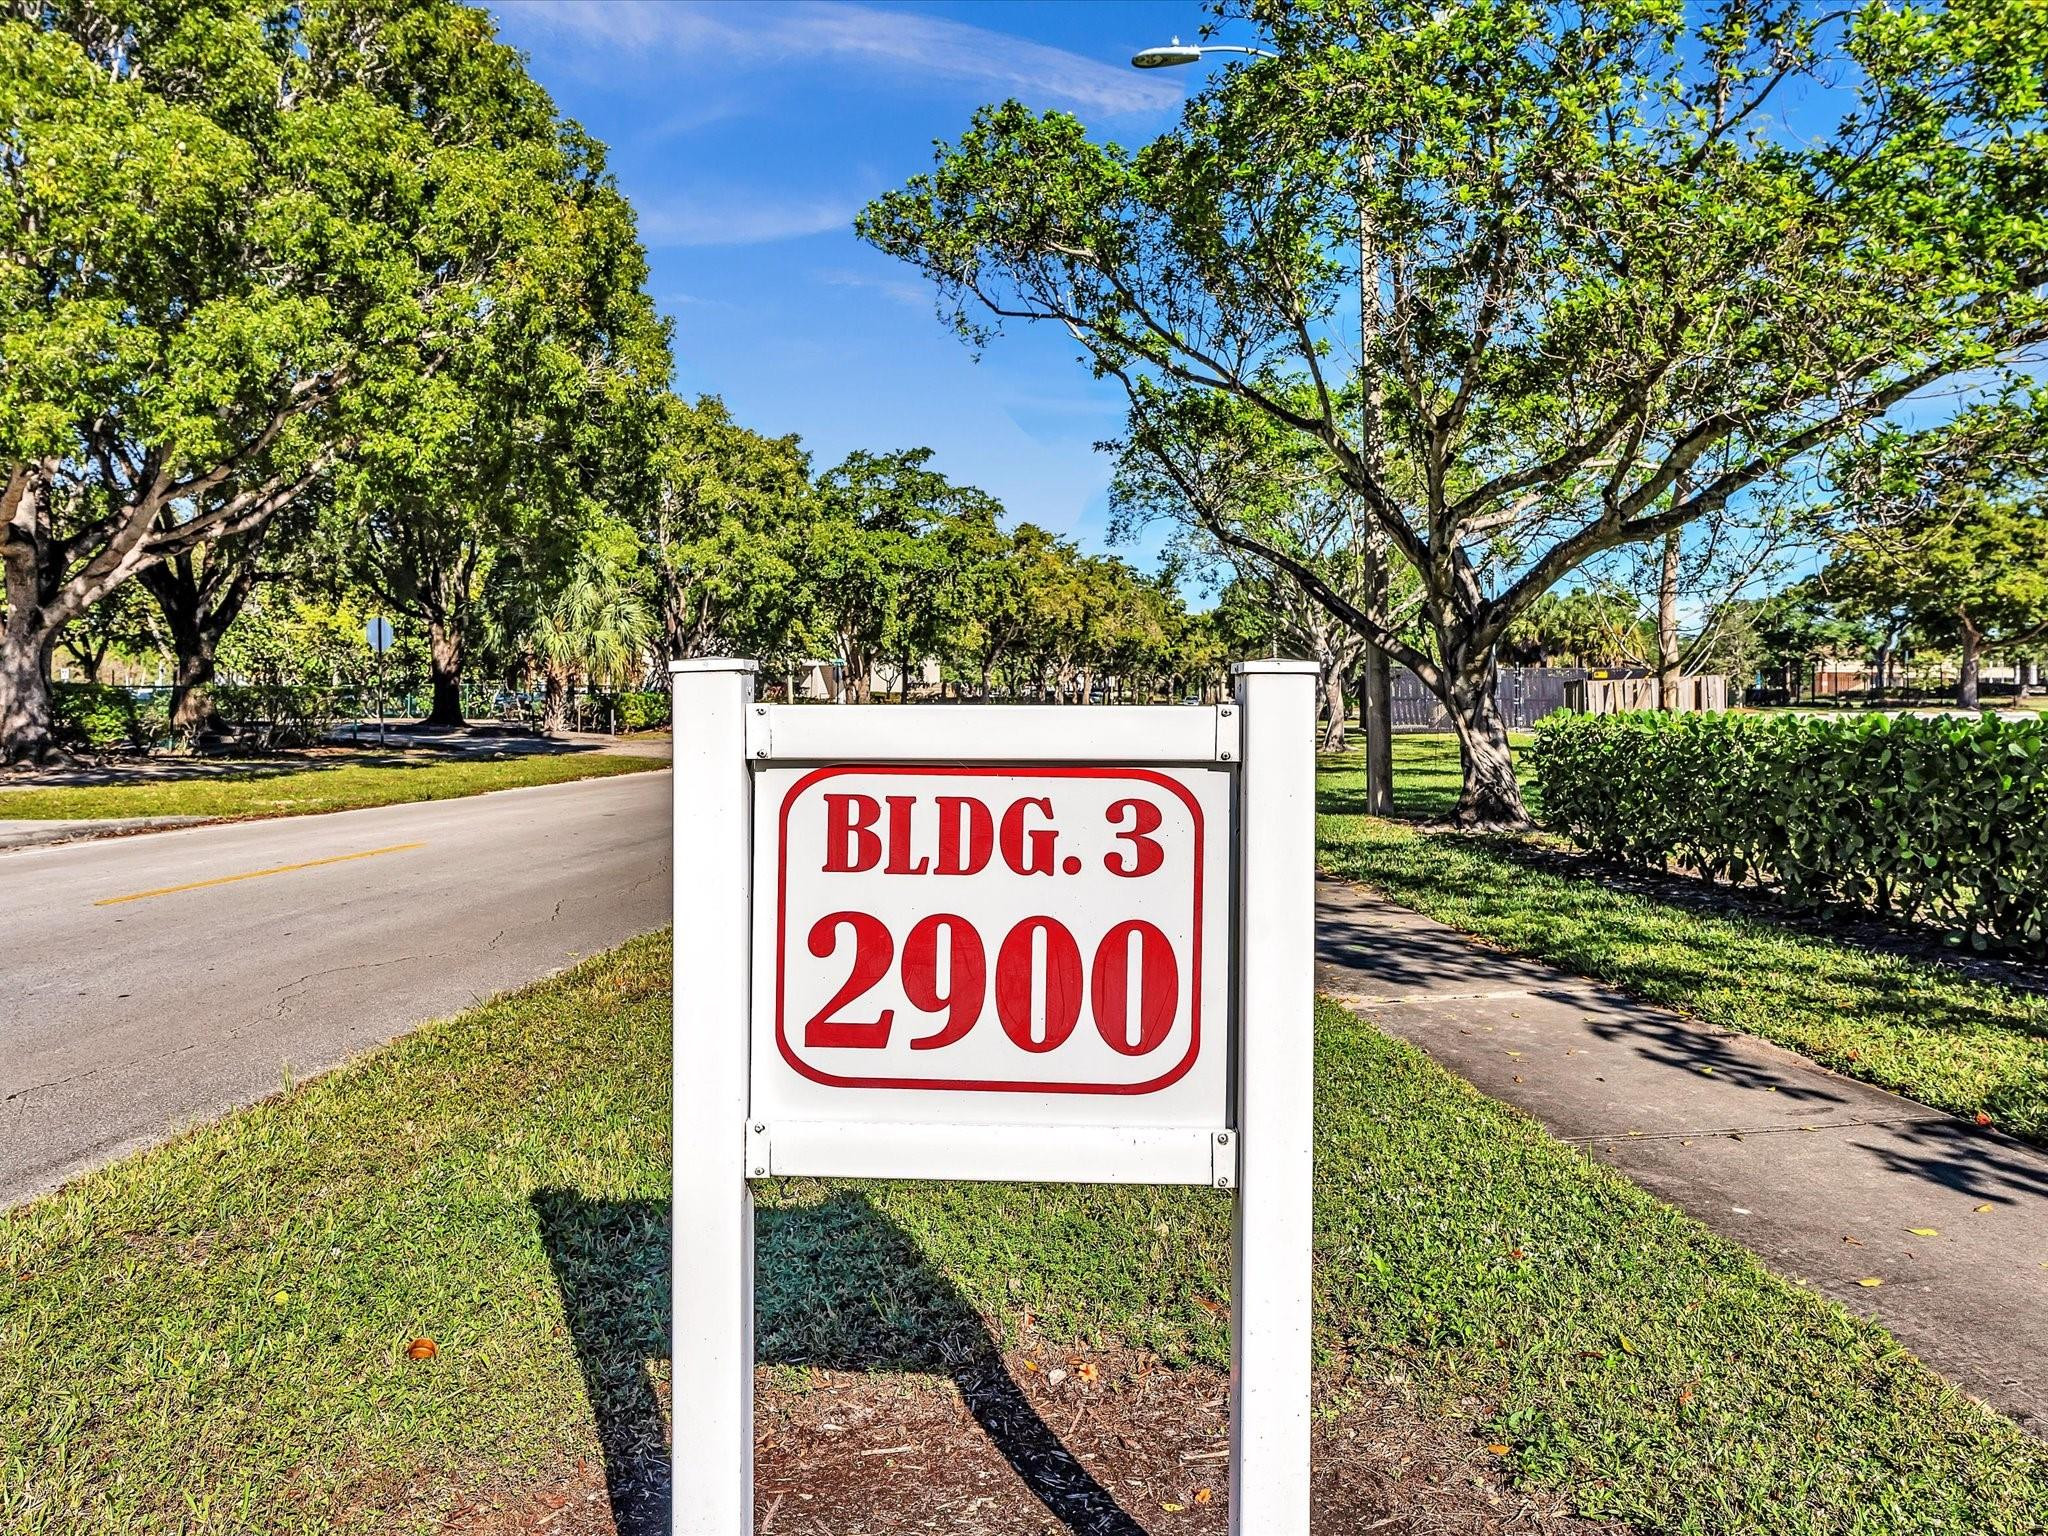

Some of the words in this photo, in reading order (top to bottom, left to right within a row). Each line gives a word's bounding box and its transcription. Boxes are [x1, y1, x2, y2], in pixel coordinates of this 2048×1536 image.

[823, 793, 1082, 877] BLDG.
[1103, 798, 1164, 878] 3
[804, 911, 1179, 1057] 2900
